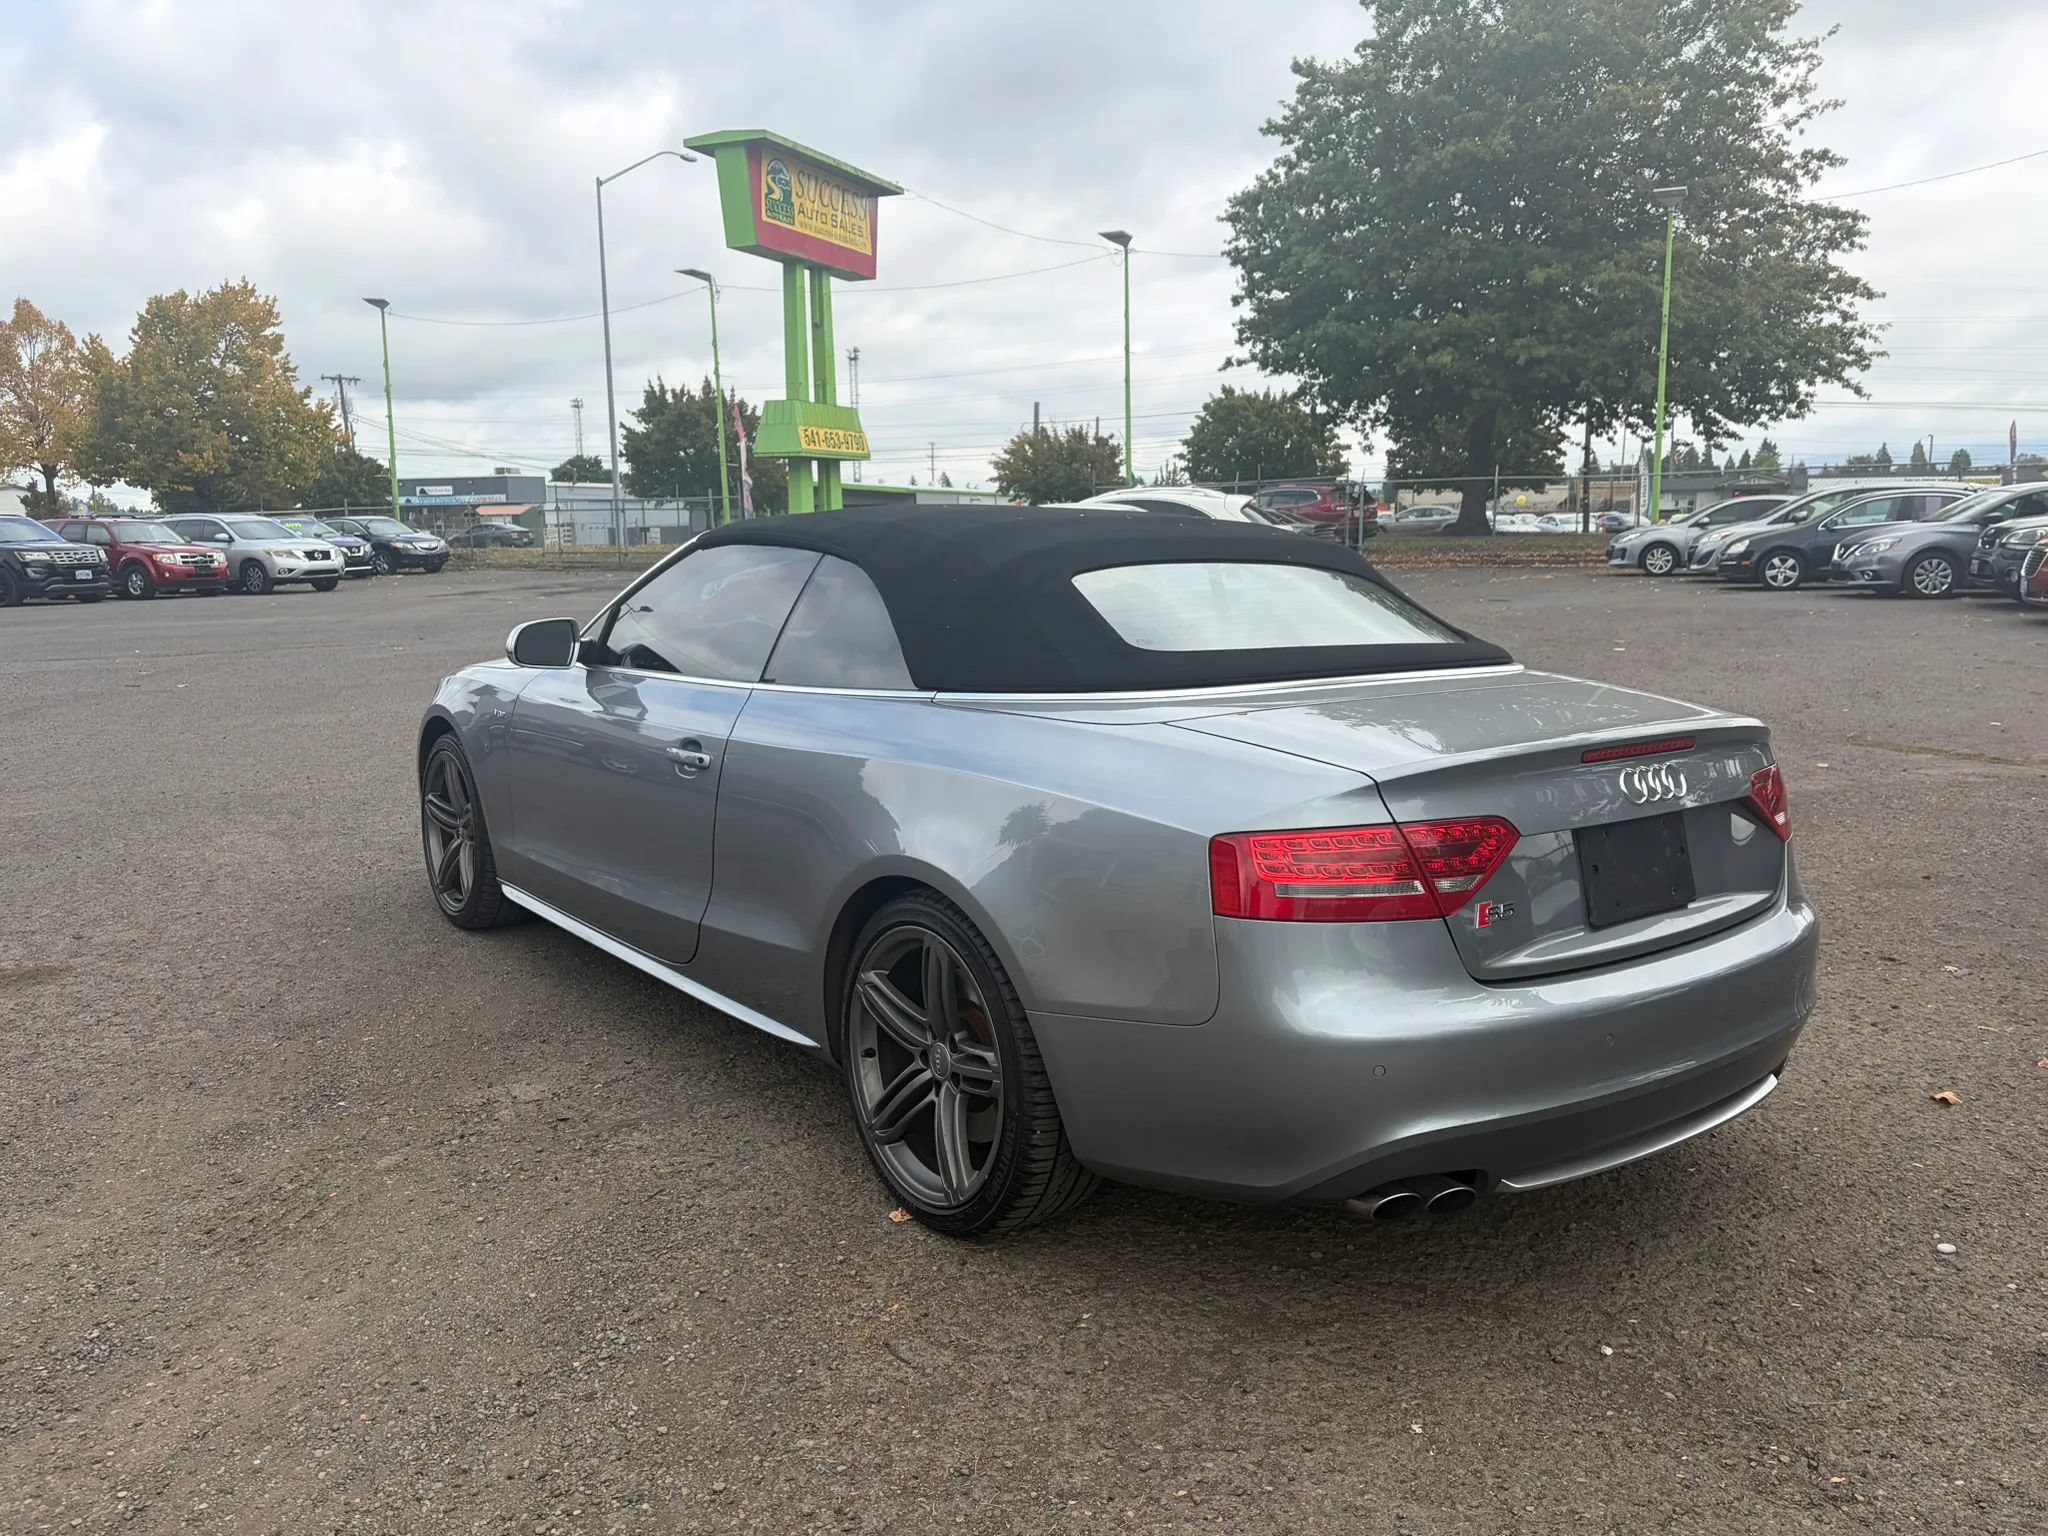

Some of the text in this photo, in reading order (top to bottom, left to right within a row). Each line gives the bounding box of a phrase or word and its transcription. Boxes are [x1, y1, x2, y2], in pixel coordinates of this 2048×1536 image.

[766, 198, 794, 217] SUCCESS
[796, 170, 868, 222] SUCCESS
[798, 202, 828, 225] AUTO
[831, 214, 864, 238] SALES
[804, 428, 865, 451] 541-653-9790
[1482, 900, 1515, 923] S5
